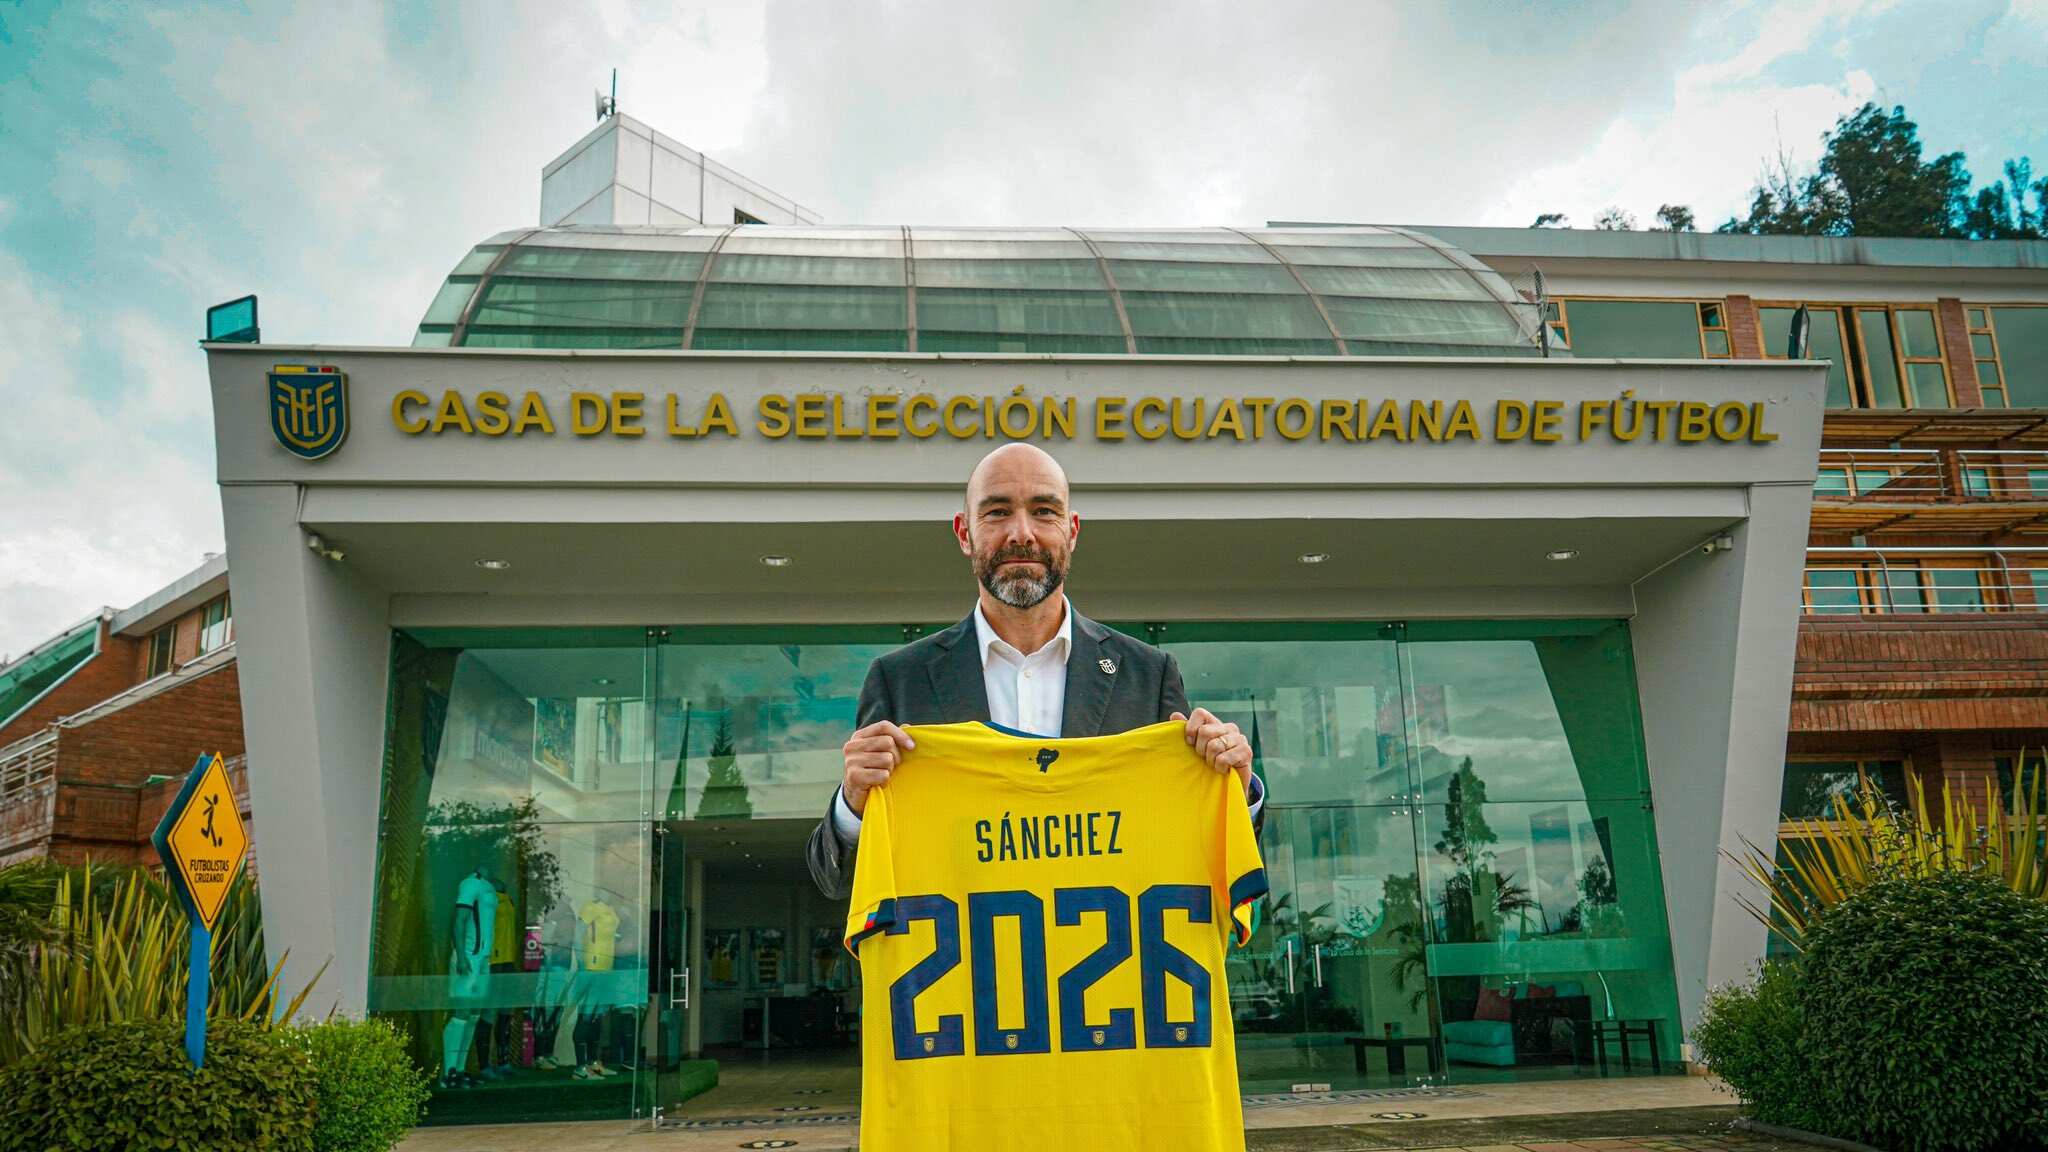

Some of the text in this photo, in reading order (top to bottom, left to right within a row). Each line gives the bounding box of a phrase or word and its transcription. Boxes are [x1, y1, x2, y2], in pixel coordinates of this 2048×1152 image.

[392, 385, 1778, 444] CASA DE LA SELECCIÓN ECUATORIANA DE FÚTBOL
[975, 811, 1123, 863] SÁNCHEZ
[190, 859, 229, 871] FUTBOLISTAS
[194, 872, 224, 883] CRUZANDO
[885, 884, 1213, 1060] 2026
